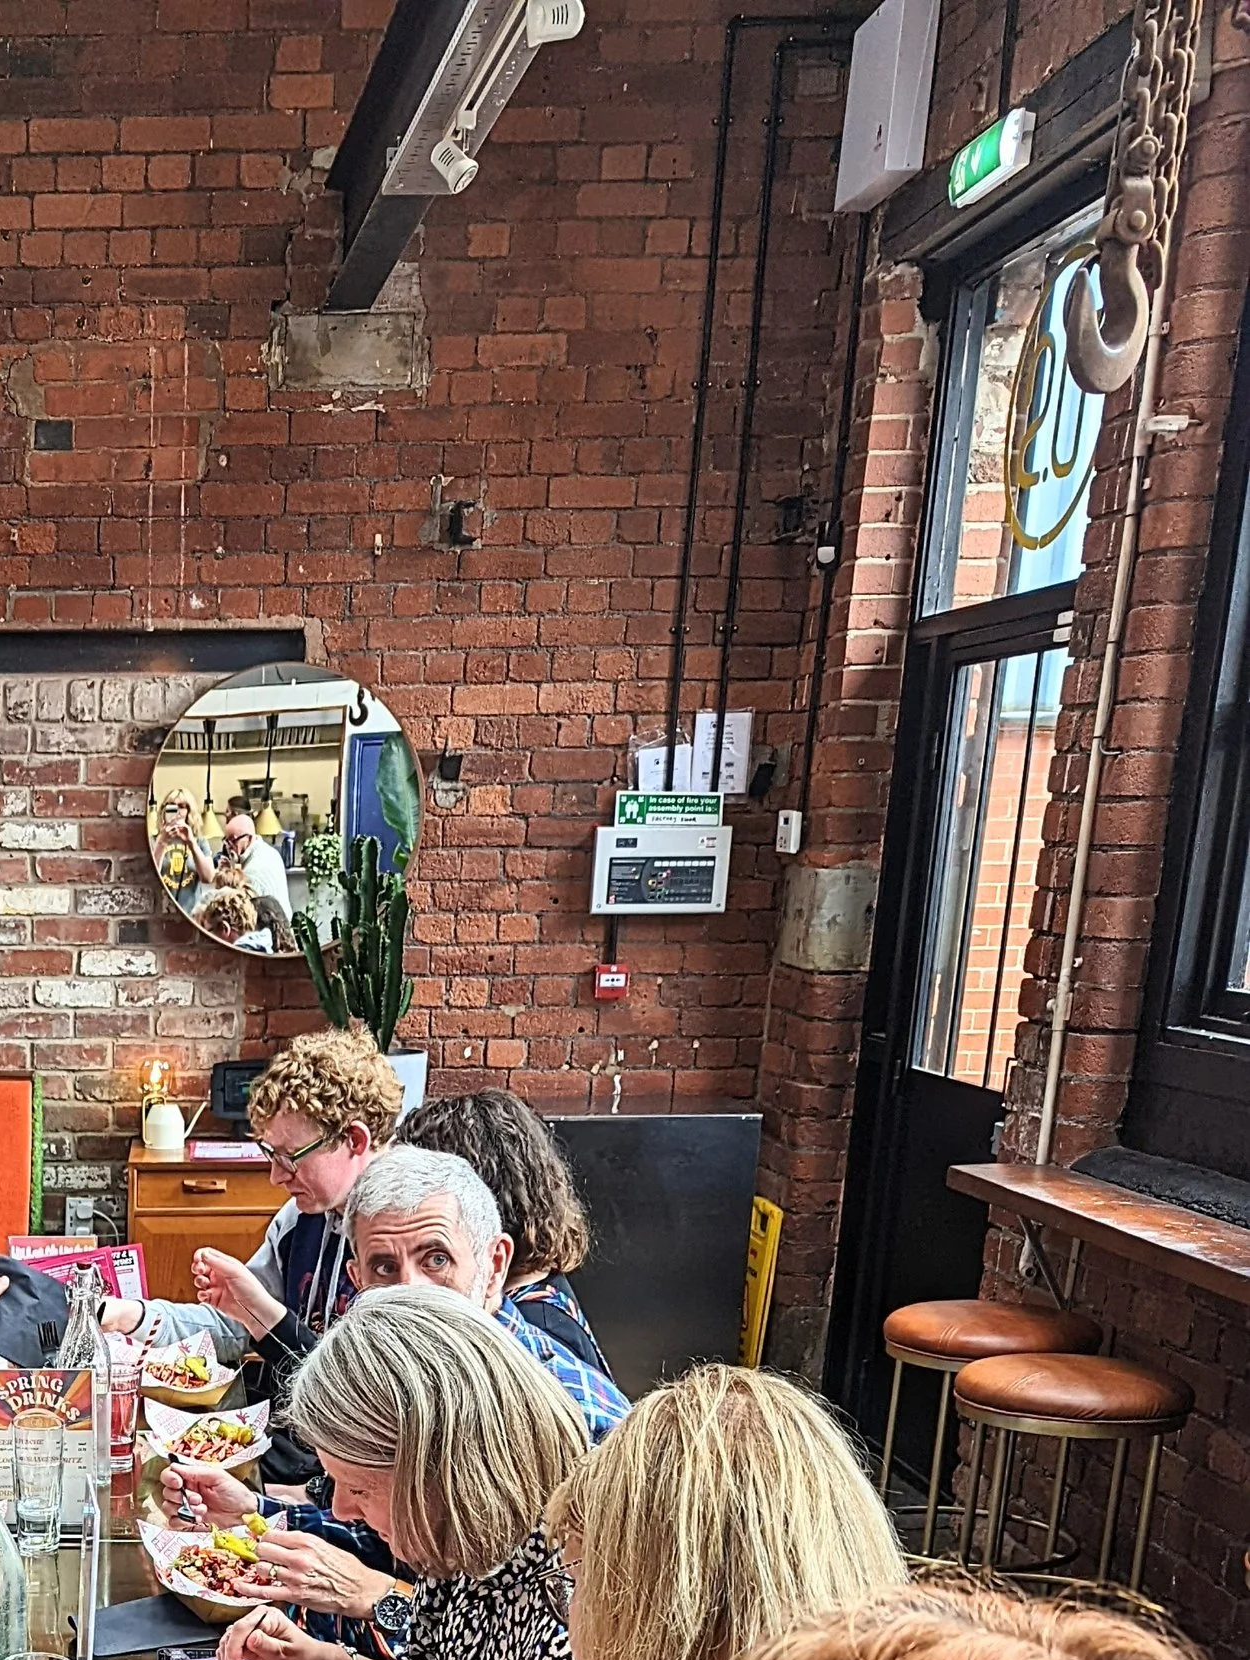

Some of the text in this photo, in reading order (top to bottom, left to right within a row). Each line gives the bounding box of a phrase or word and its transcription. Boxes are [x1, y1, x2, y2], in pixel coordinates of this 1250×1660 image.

[677, 796, 685, 804] of
[686, 796, 698, 804] fire
[648, 805, 684, 813] assembly
[7, 1392, 81, 1421] DRINKS
